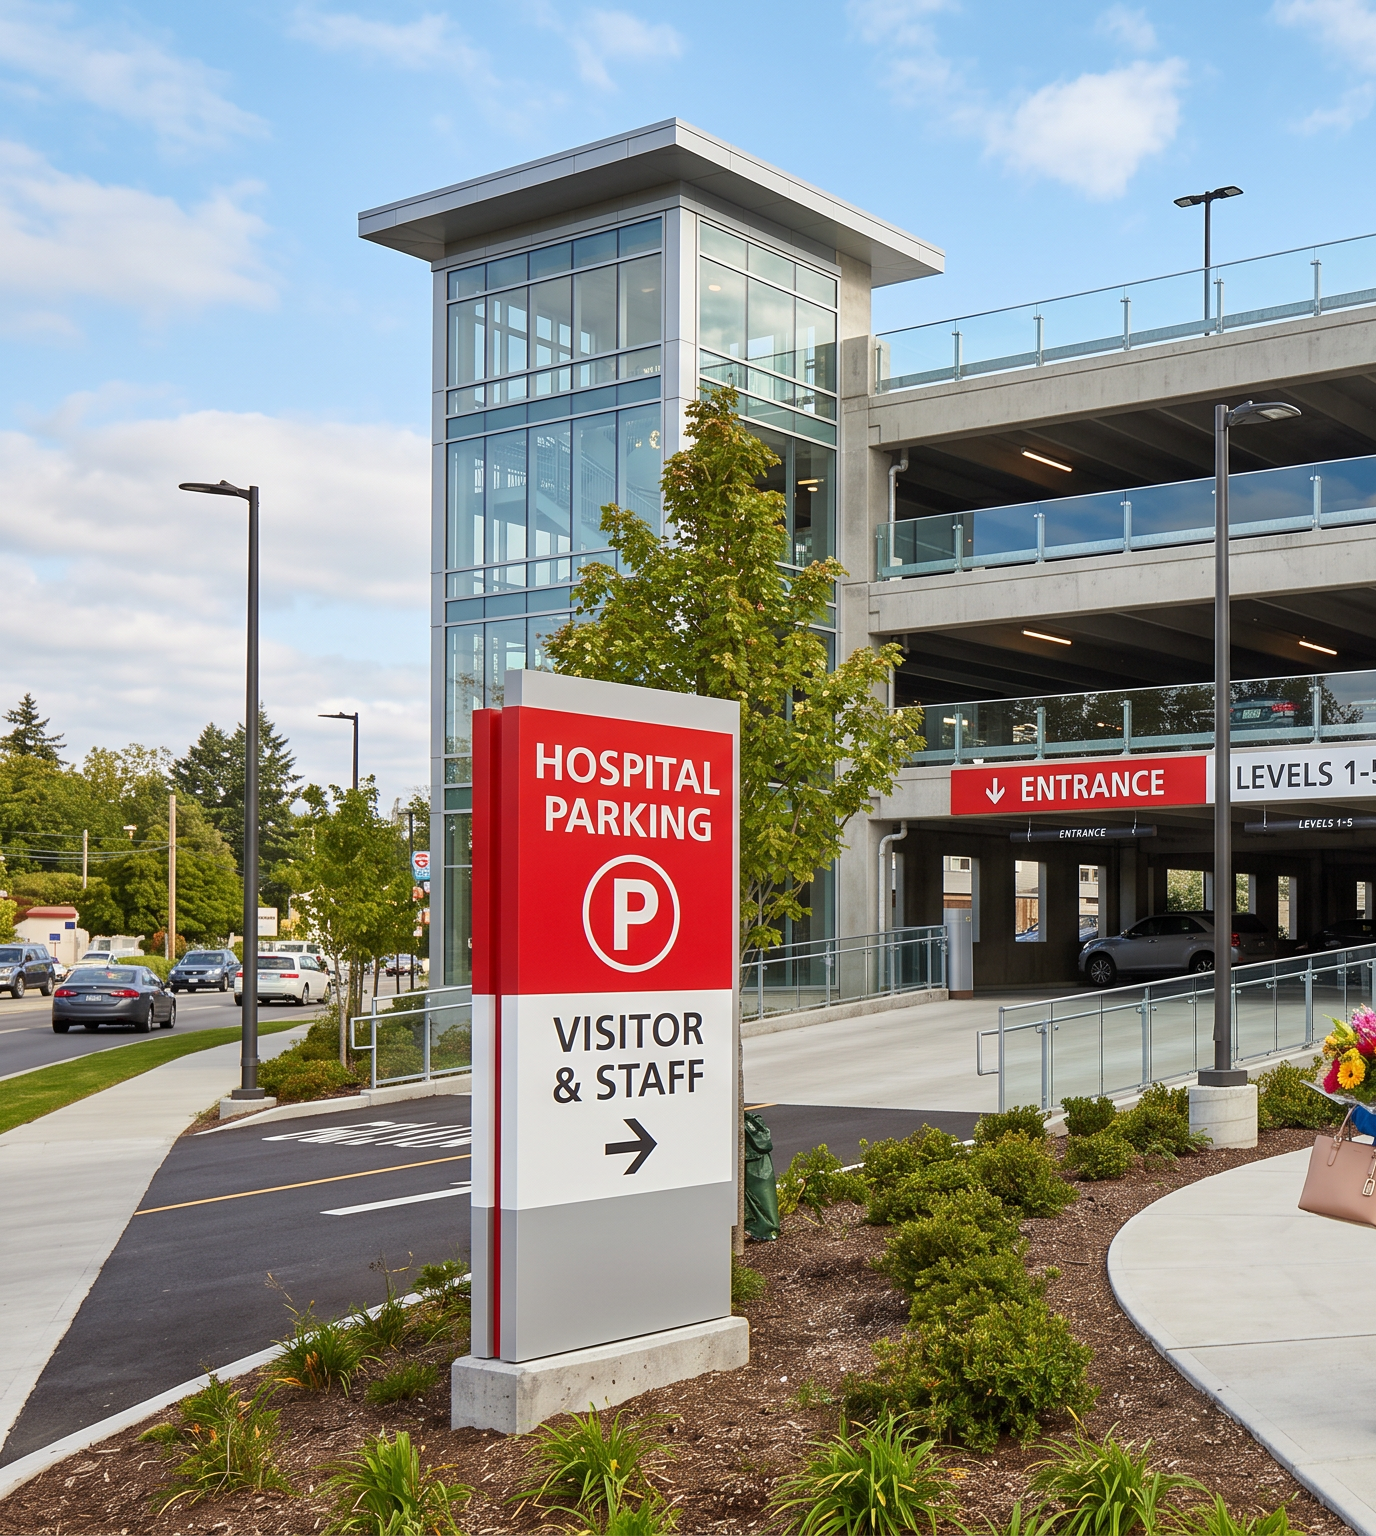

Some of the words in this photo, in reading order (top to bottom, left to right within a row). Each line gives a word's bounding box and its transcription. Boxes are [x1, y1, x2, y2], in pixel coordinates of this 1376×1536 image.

[535, 742, 721, 797] HOSPITAL
[1020, 768, 1166, 803] ENTRANCE
[1236, 761, 1333, 791] LEVELS
[545, 795, 713, 842] PARKING
[1059, 827, 1107, 839] ENTRANCE
[1298, 818, 1334, 829] LEVELS
[1336, 817, 1354, 828] 1-5
[613, 877, 660, 951] P
[553, 1012, 705, 1053] VISITOR
[553, 1066, 583, 1104] &
[596, 1058, 705, 1101] STAFF
